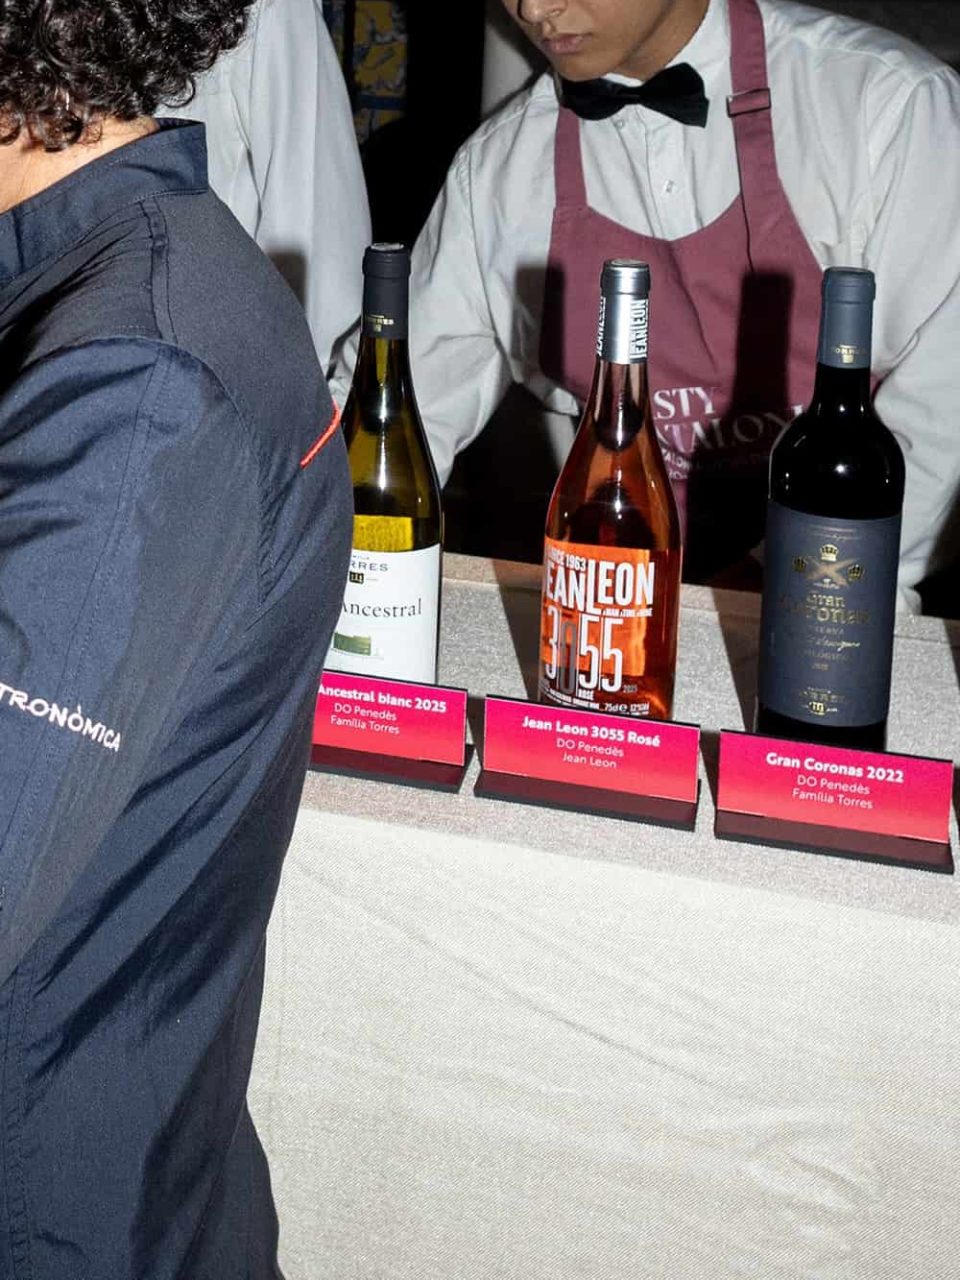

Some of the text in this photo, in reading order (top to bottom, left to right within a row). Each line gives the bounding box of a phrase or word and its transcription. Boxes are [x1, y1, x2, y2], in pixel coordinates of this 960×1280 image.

[653, 387, 720, 420] STY
[566, 554, 586, 571] 1963
[545, 605, 624, 693] 3055
[318, 684, 447, 713] Ancestral blanc 2025
[334, 703, 397, 721] DO Penedès
[370, 721, 400, 735] Torres
[522, 716, 661, 747] Jean Leon 3055 Rosé
[556, 738, 624, 757] DO Penedès
[562, 752, 617, 769] Jean Leon
[766, 752, 904, 783] Gran Coronas 2022
[797, 775, 870, 795] DO Penedès
[838, 794, 873, 809] Torres
